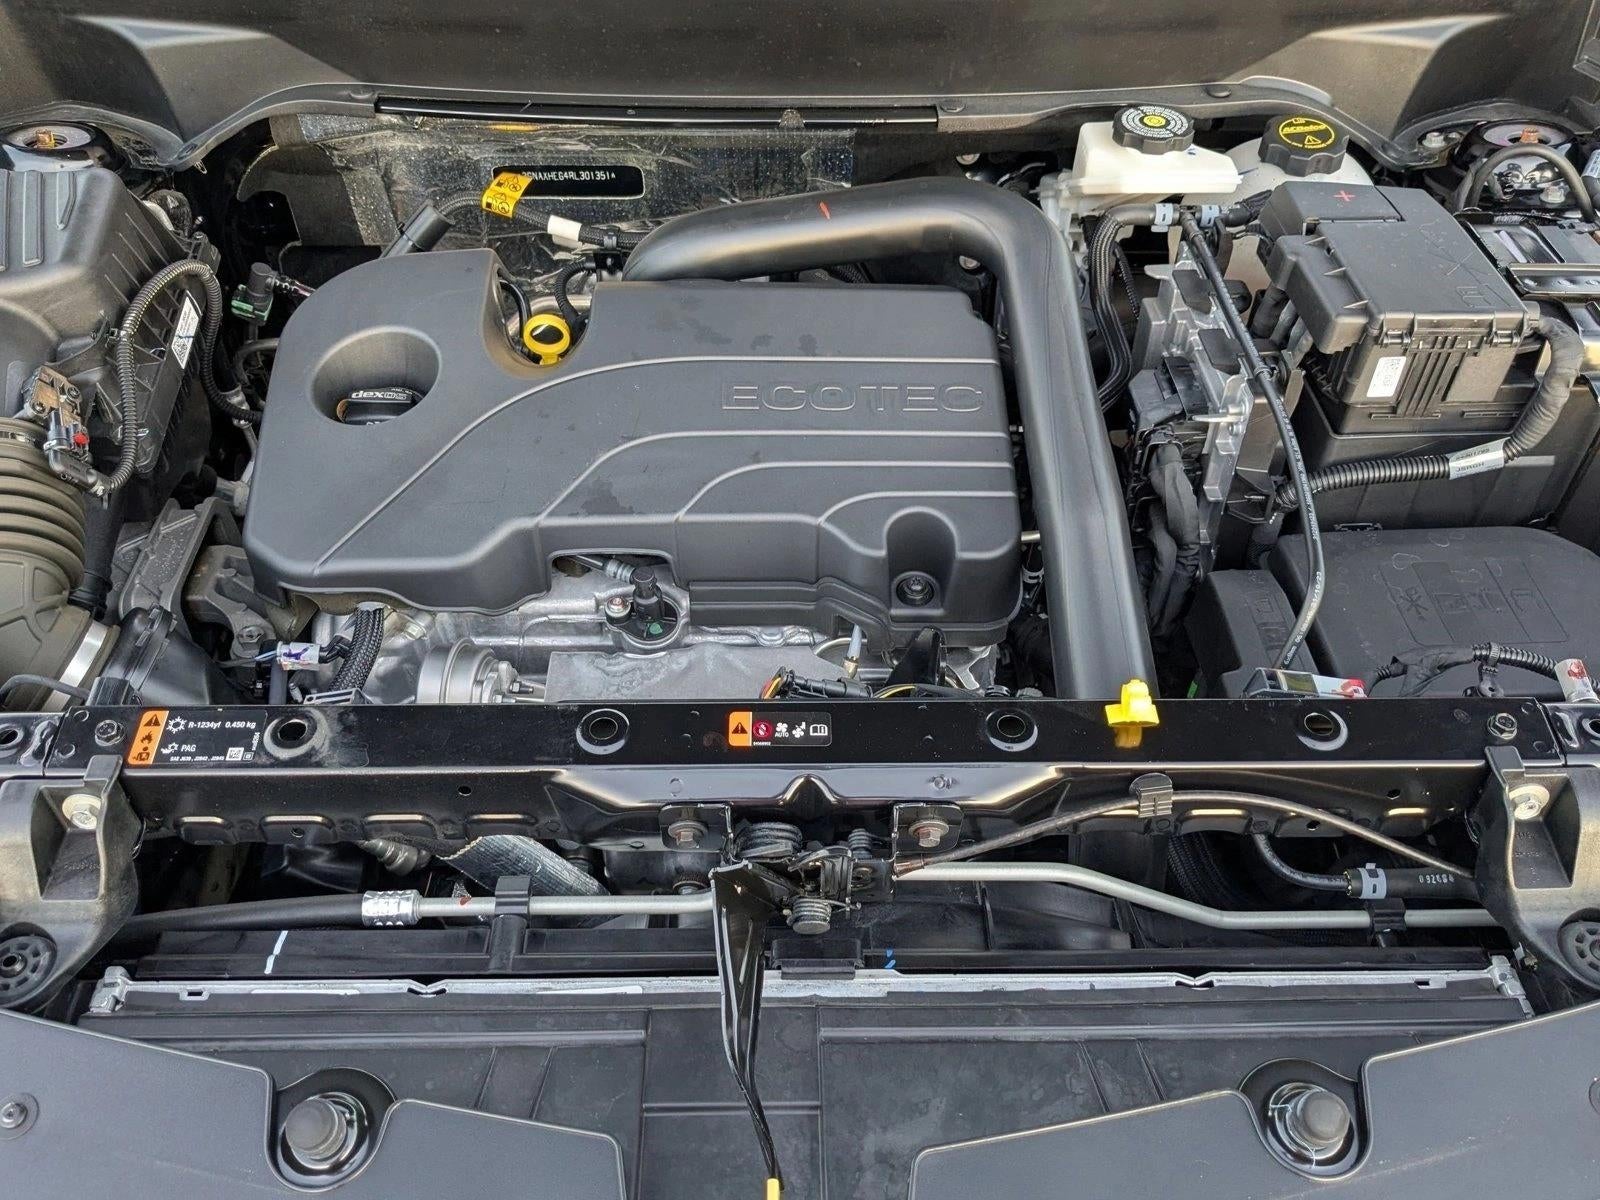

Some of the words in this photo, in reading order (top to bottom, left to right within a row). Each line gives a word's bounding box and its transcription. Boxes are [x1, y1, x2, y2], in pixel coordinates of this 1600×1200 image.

[351, 391, 407, 400] dexos
[722, 384, 983, 412] ECOTEC
[188, 721, 221, 729] R-1234yf
[225, 721, 245, 729] 0.450
[246, 721, 256, 729] kg
